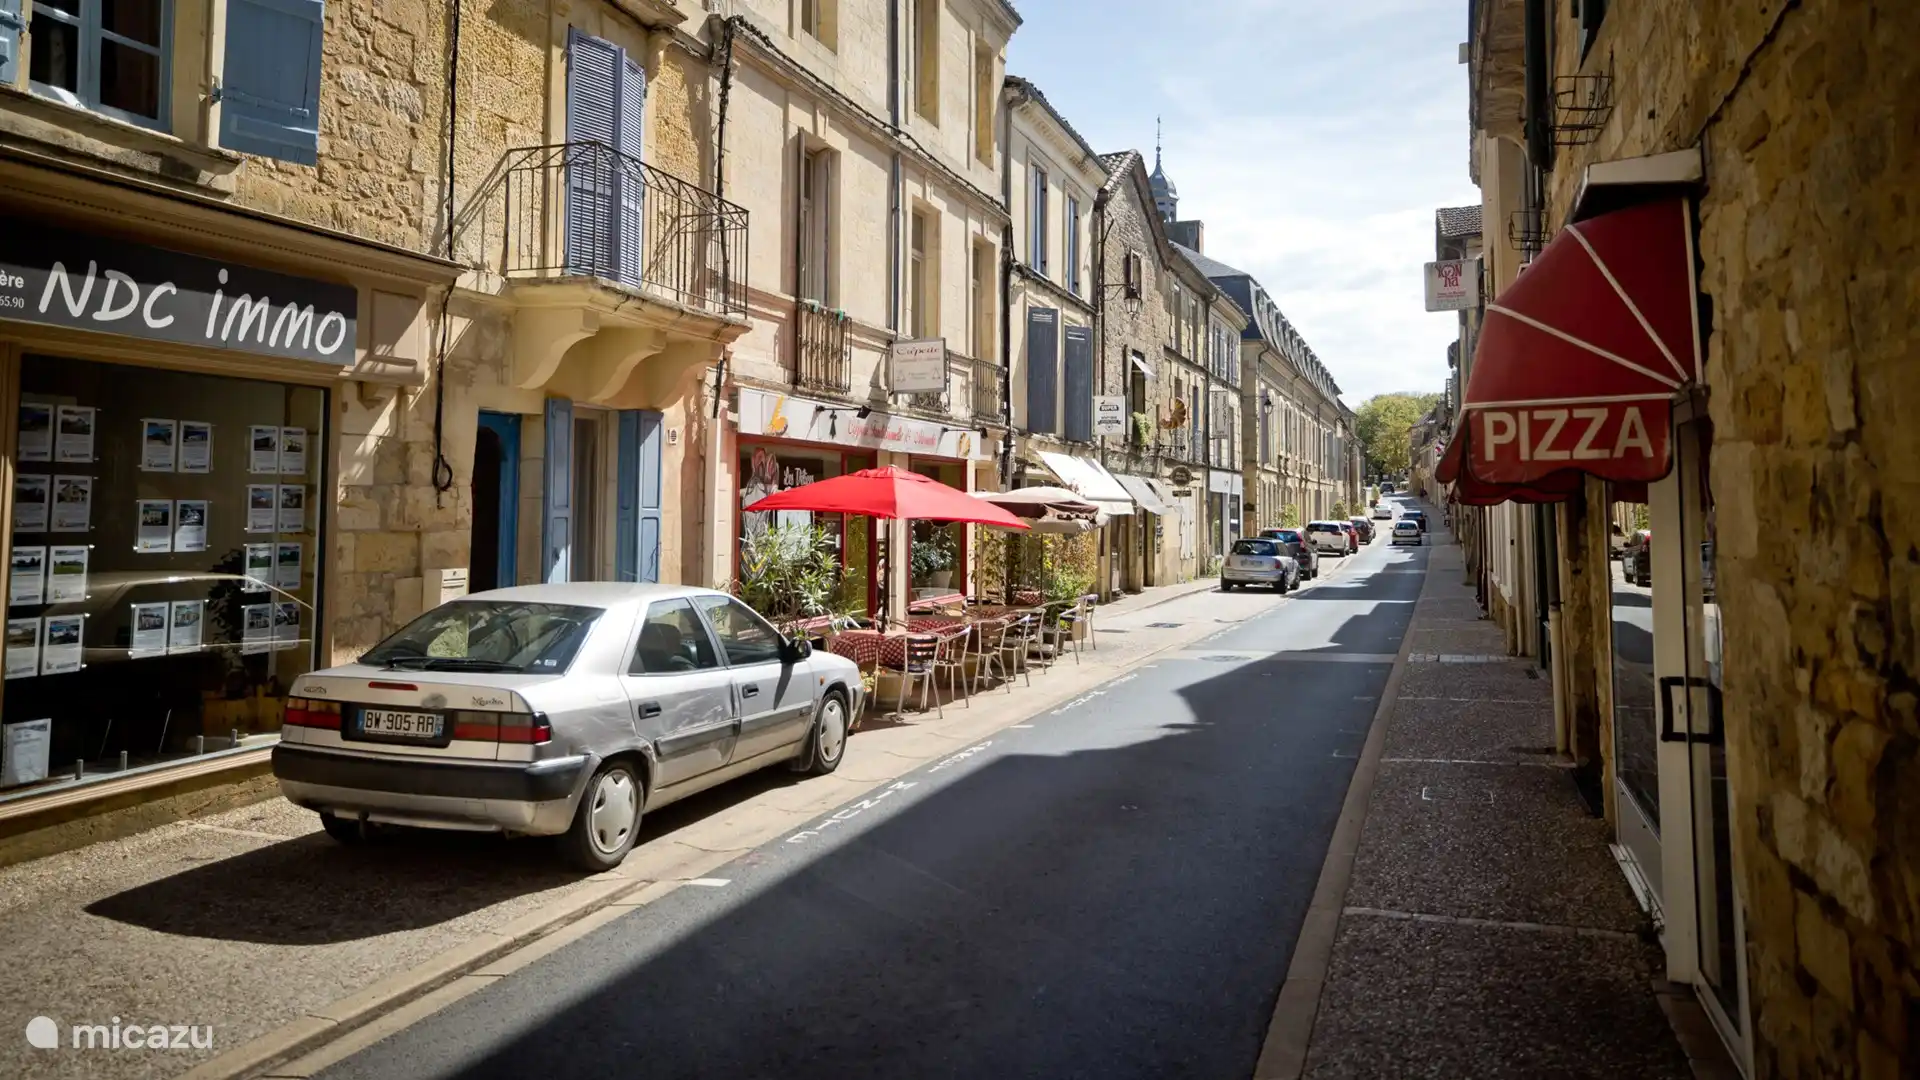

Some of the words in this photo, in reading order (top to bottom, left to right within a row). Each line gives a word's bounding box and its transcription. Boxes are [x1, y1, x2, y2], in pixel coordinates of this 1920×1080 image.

[38, 259, 178, 330] NDC
[1483, 406, 1654, 462] PIZZA
[785, 781, 920, 844] MINUTE
